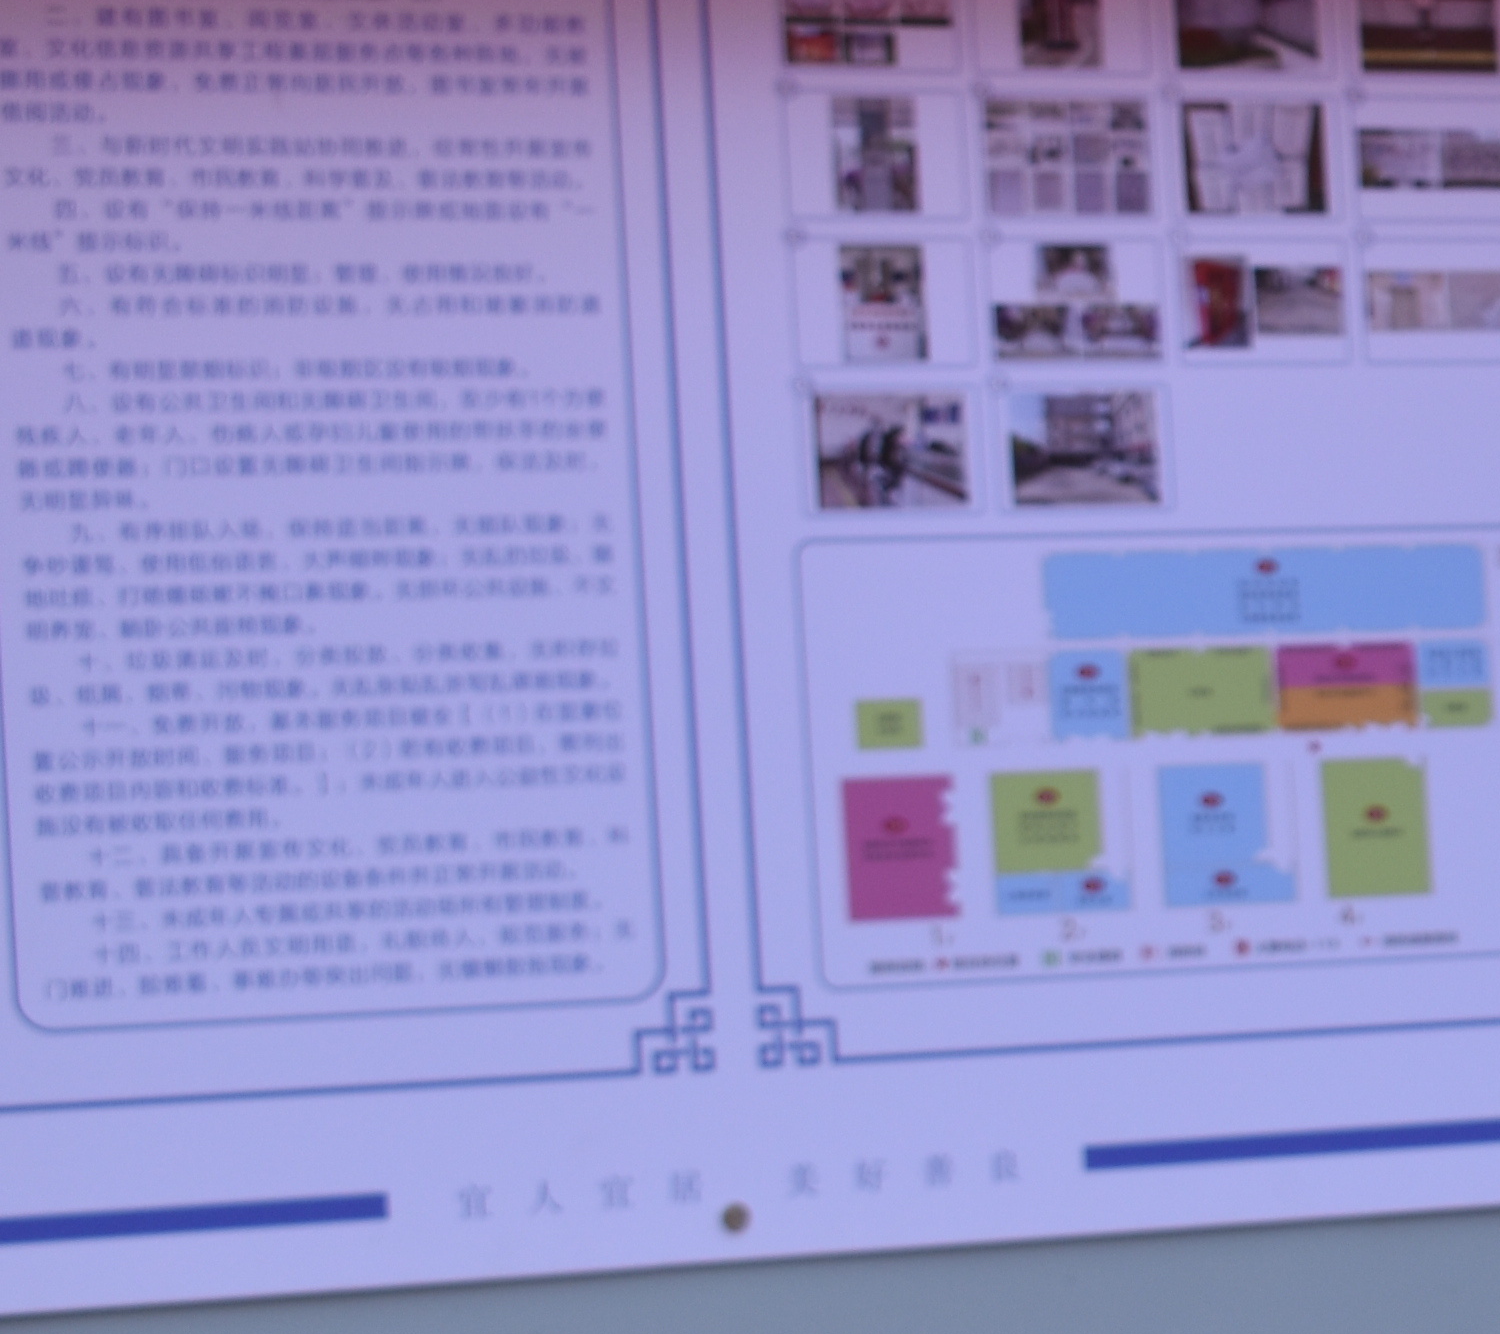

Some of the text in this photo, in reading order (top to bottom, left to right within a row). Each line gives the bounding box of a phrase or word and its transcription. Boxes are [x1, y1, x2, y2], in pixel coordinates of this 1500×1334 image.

[456, 1146, 1024, 1223] 宜人宜居 美好善良
